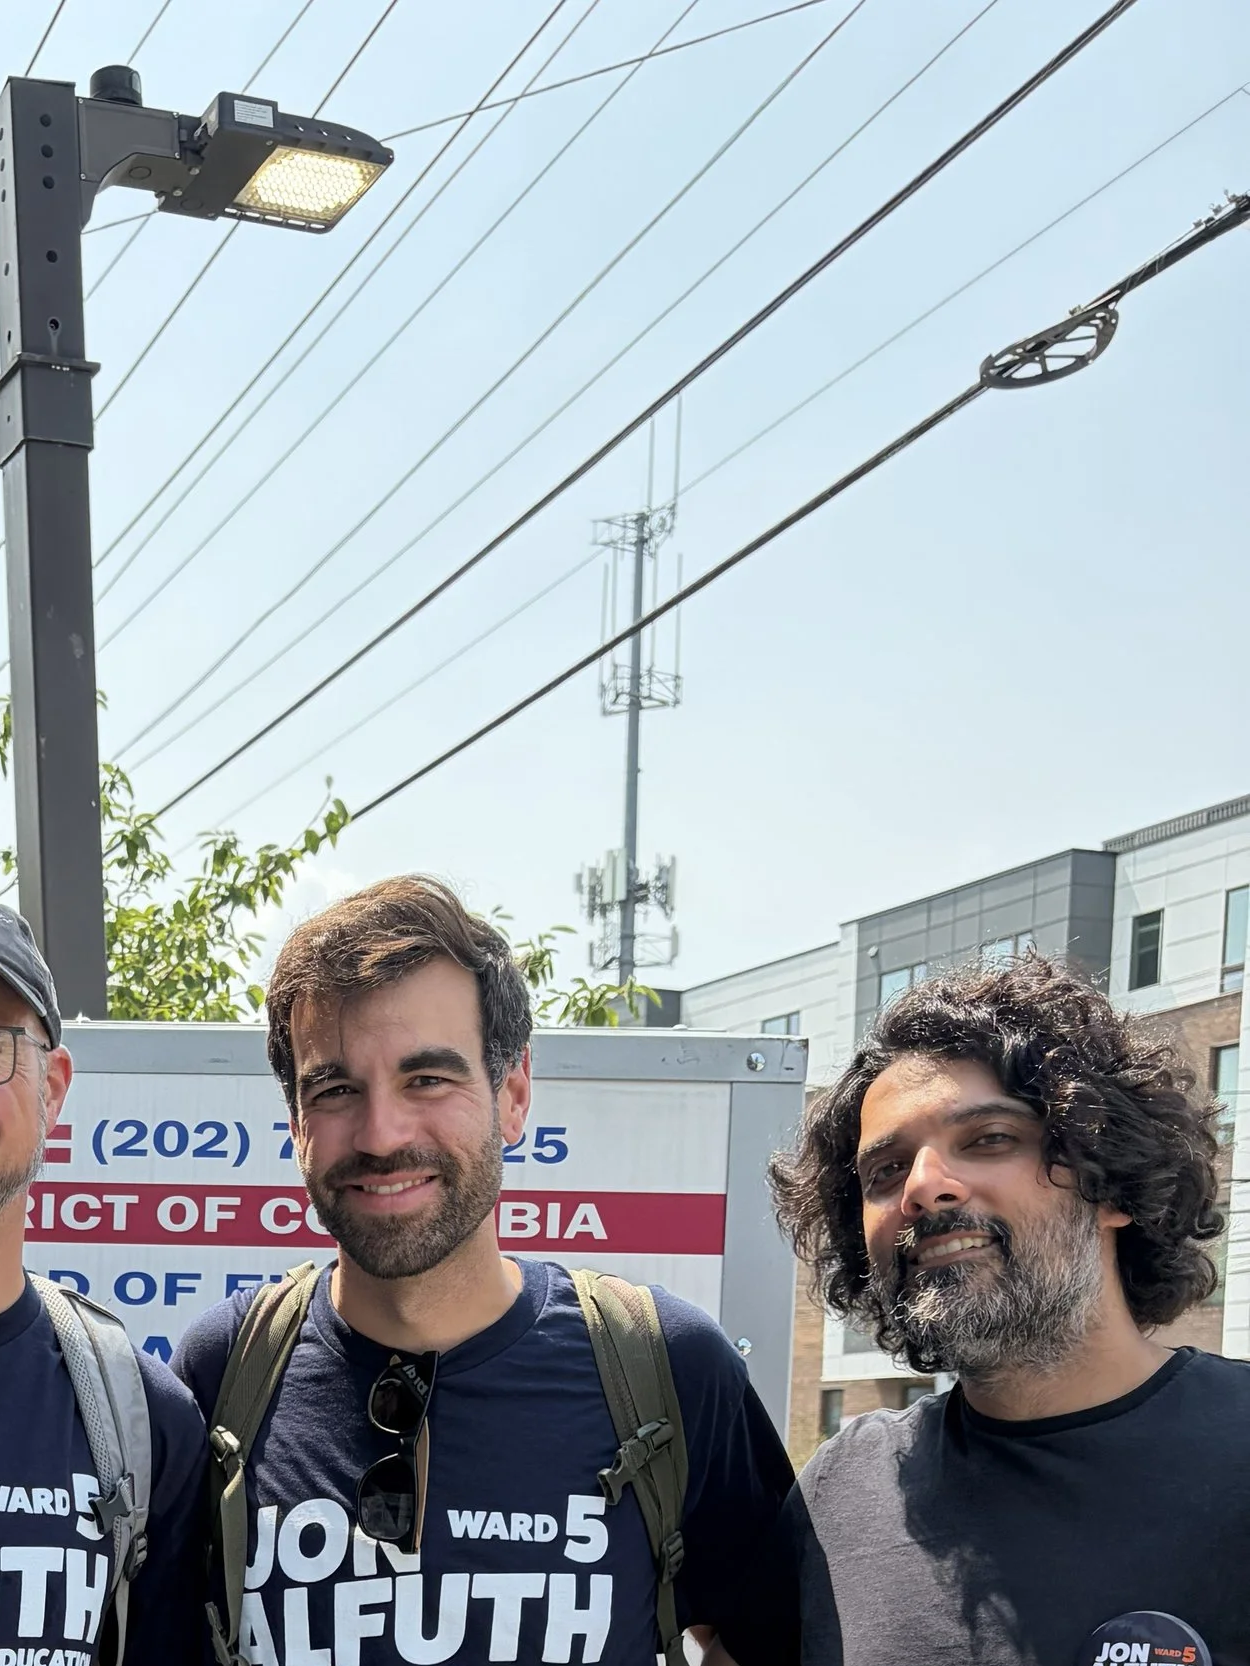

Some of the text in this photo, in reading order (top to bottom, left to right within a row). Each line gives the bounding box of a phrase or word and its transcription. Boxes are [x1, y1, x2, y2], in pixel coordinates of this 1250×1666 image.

[92, 1119, 250, 1167] (202)
[157, 1195, 241, 1233] OF
[114, 1271, 202, 1307] OF
[71, 1473, 105, 1541] 5
[447, 1509, 559, 1543] WARD
[563, 1494, 609, 1563] 5
[1095, 1642, 1196, 1663] JON WARD 5
